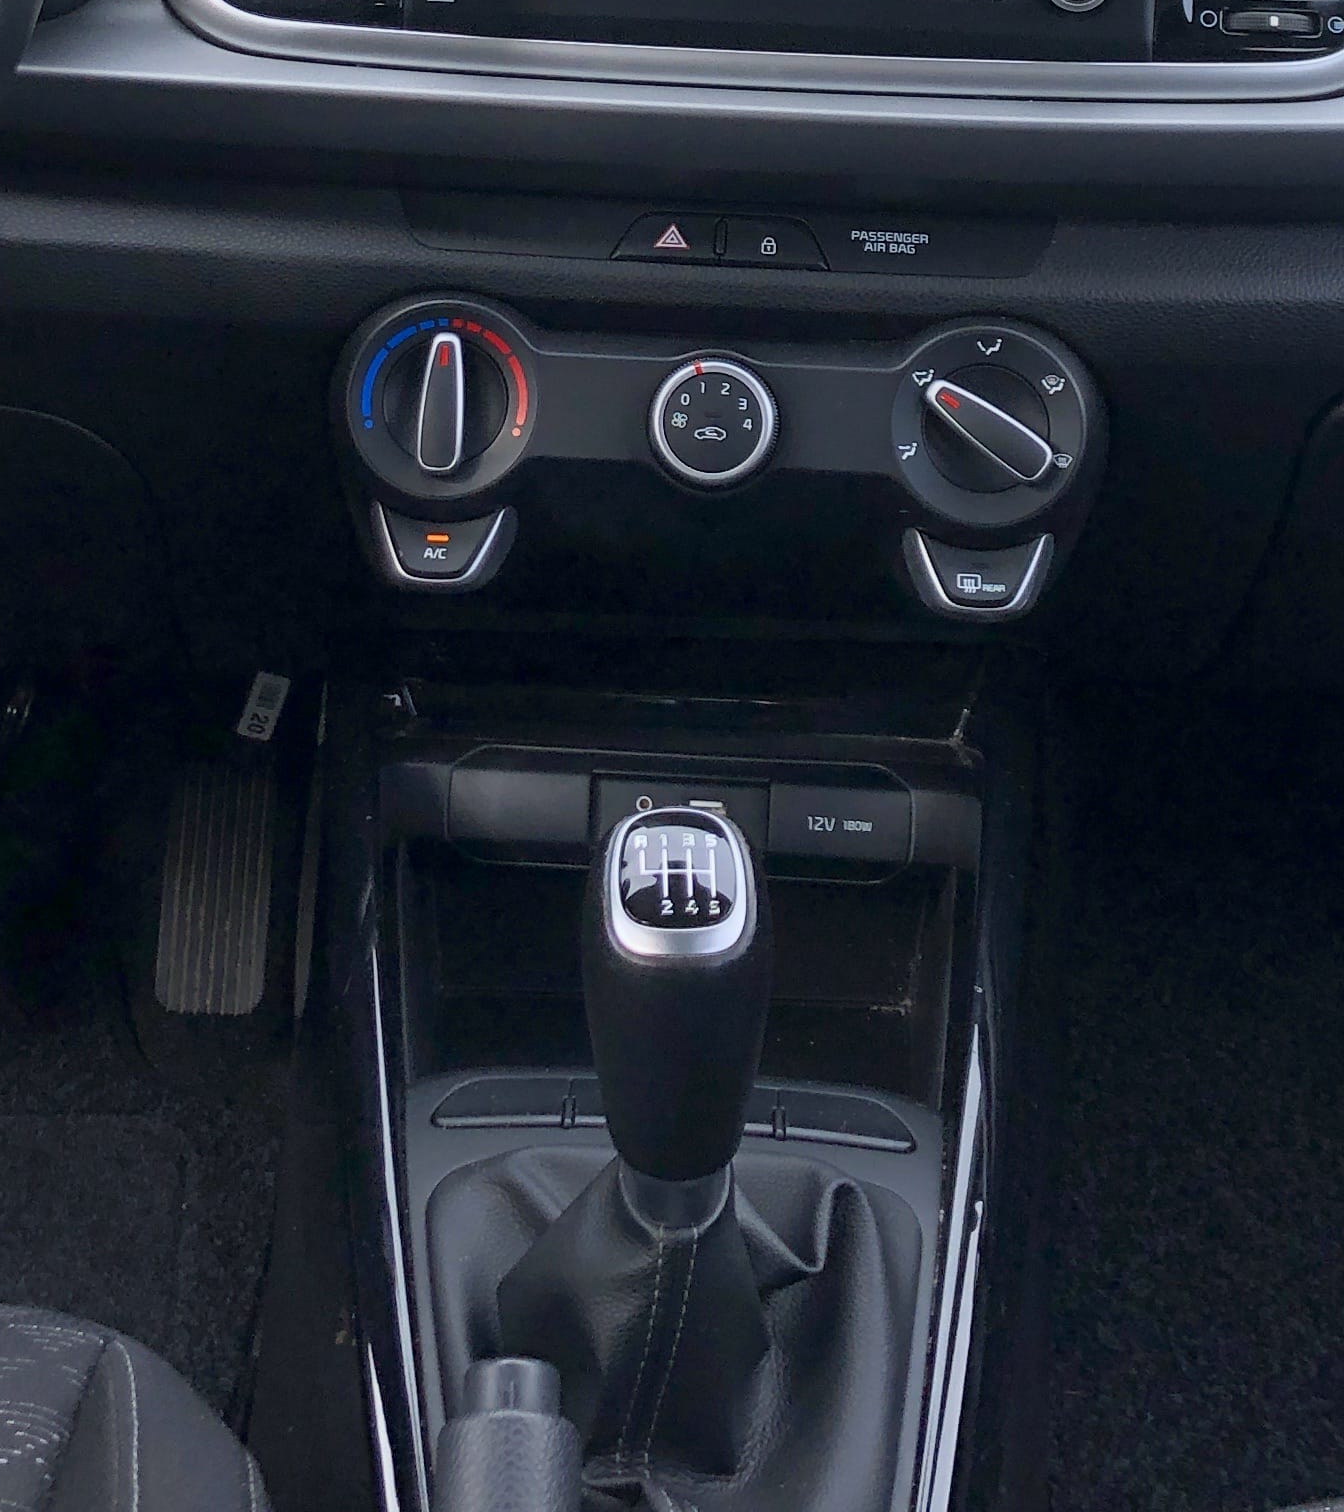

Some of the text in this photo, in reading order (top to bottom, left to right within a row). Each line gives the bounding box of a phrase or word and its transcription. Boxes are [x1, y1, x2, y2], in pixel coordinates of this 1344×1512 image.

[851, 230, 929, 244] PASSENGER
[863, 242, 916, 254] AIR BAG
[699, 381, 706, 394] 1
[720, 382, 731, 395] 2
[680, 393, 690, 406] 0
[738, 397, 748, 410] 3
[742, 418, 753, 431] 4
[423, 547, 447, 560] A/C
[982, 583, 1006, 593] REAR
[807, 815, 836, 831] 12V
[659, 833, 668, 847] 1
[682, 833, 696, 848] 3
[661, 899, 674, 916] 2
[685, 899, 699, 916] 4
